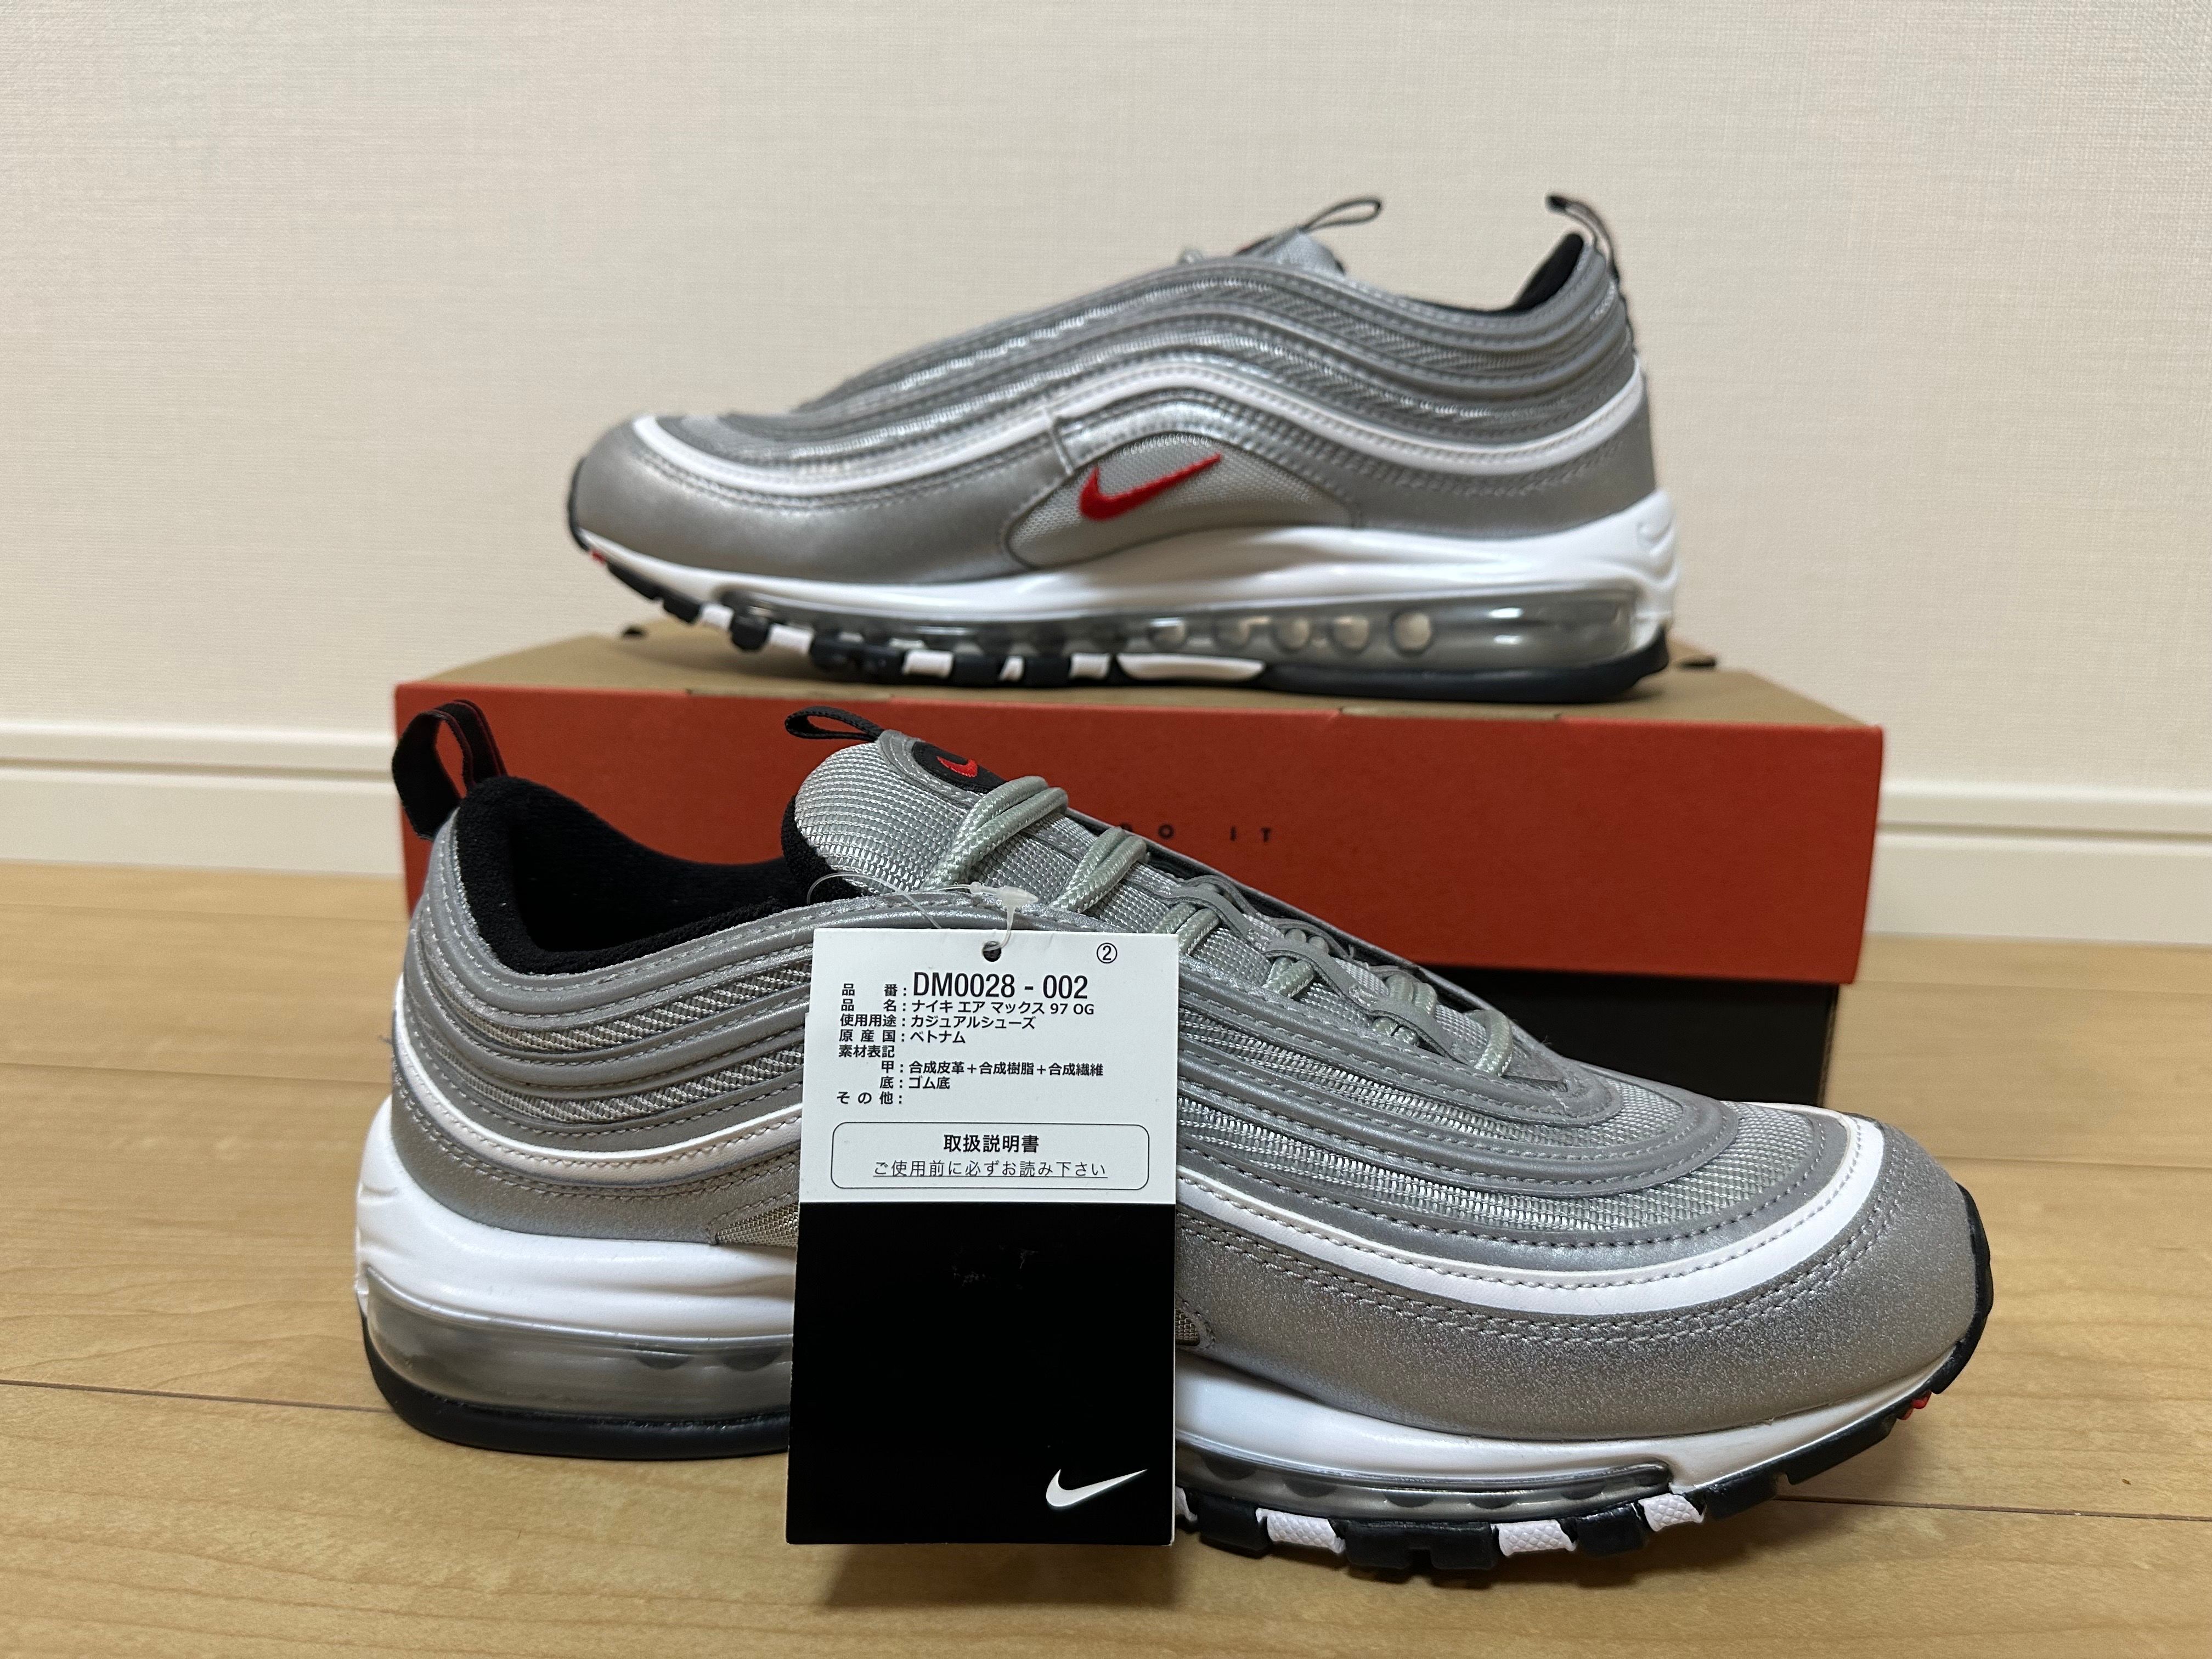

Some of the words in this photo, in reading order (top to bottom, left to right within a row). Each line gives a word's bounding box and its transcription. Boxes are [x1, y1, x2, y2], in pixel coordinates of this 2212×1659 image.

[1229, 825, 1272, 842] IT
[913, 972, 1015, 998] DM0028
[1043, 974, 1088, 999] 002
[1050, 1003, 1068, 1015] 97
[1073, 1003, 1094, 1015] OG
[838, 1044, 895, 1058] 素材表記
[943, 1134, 1040, 1153] 取扱説明書
[873, 1160, 1107, 1177] ご使用前に必ずお読み下さい
